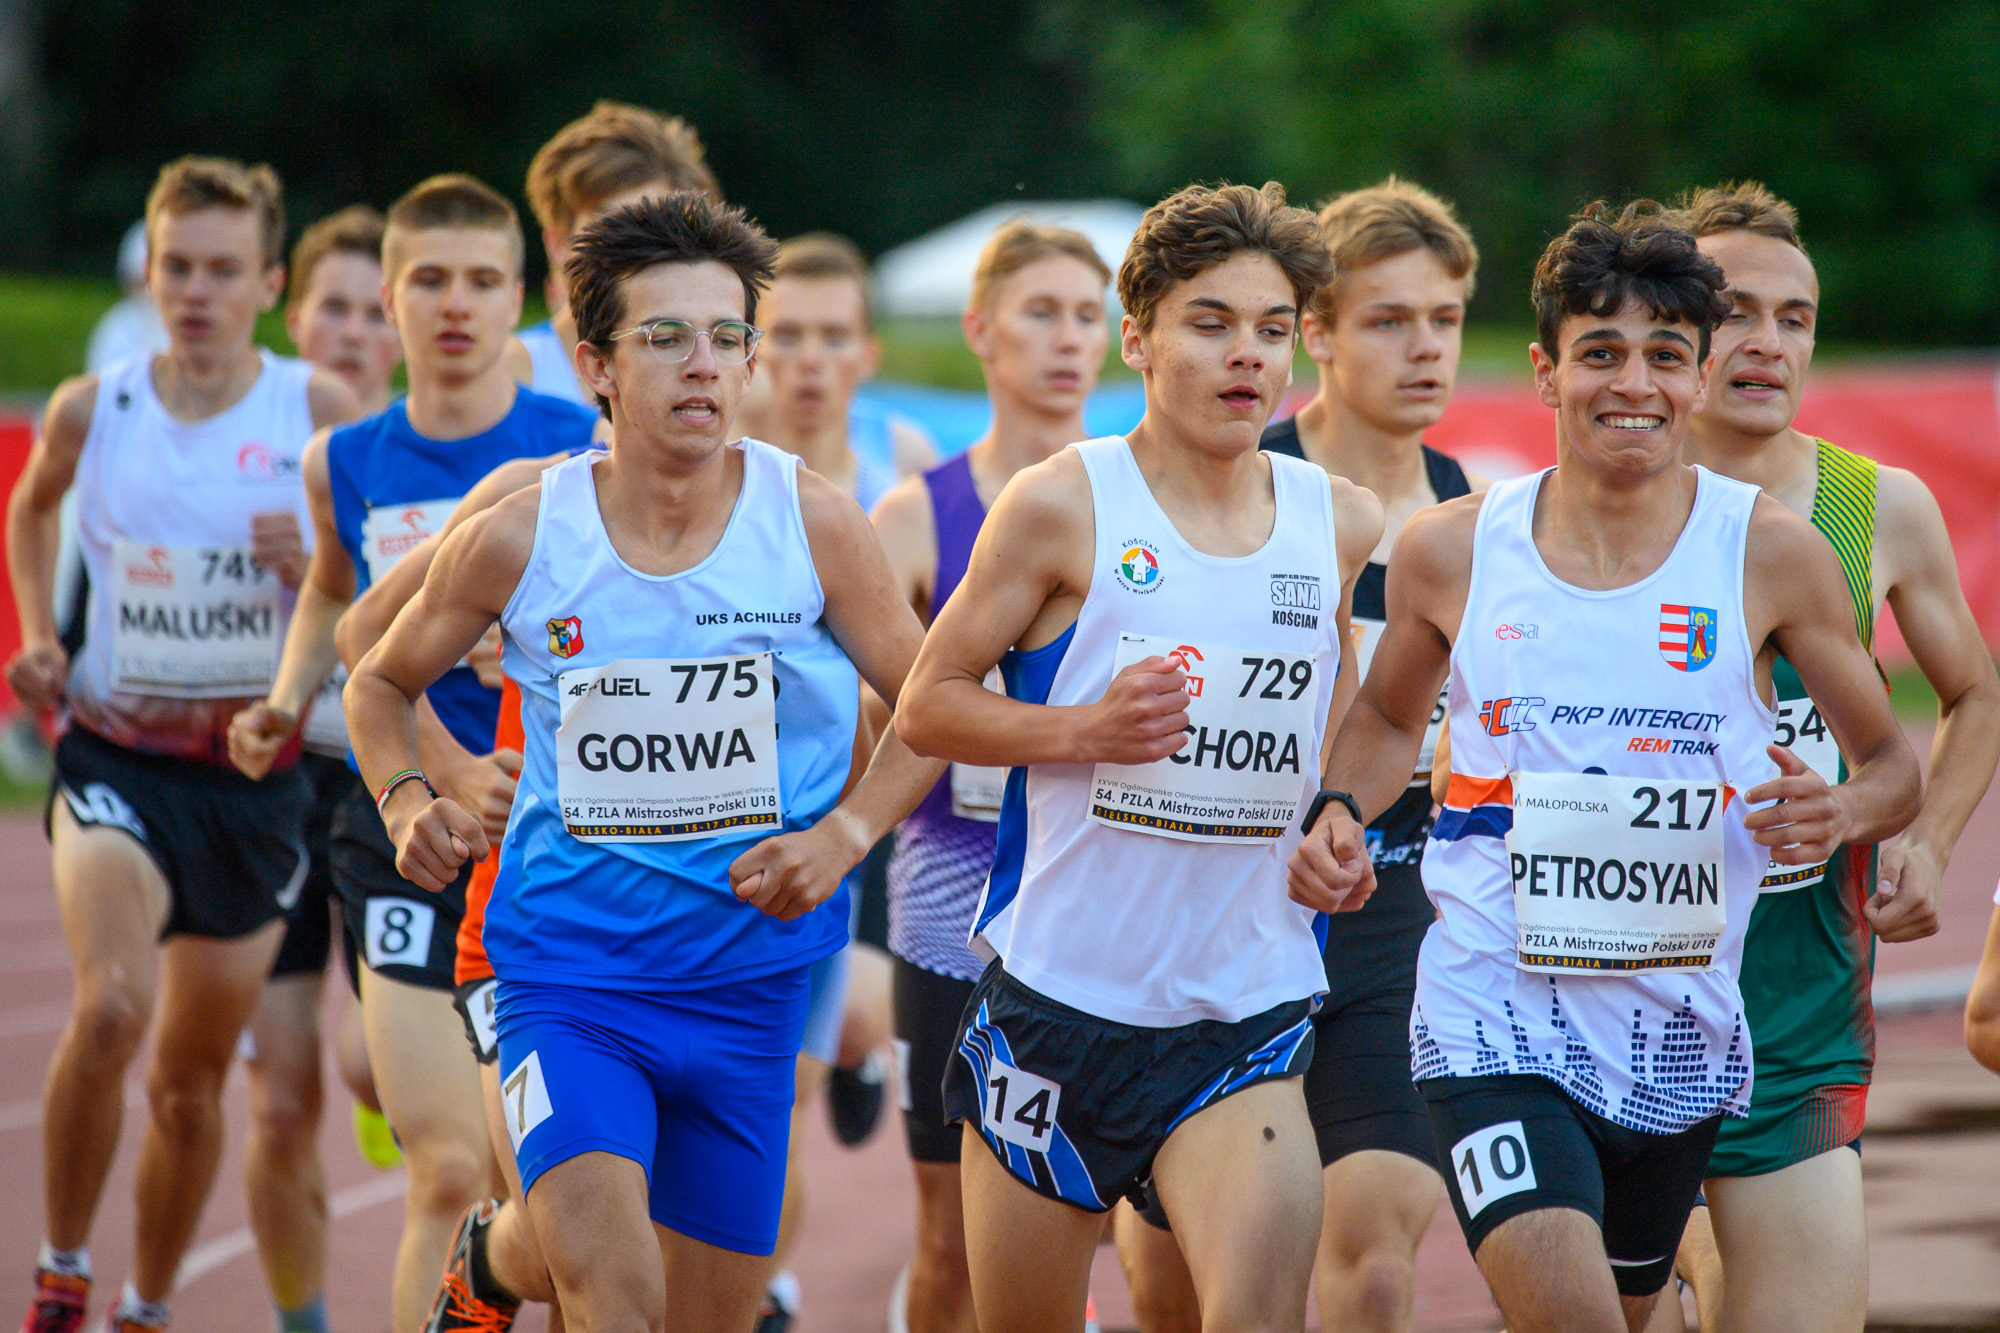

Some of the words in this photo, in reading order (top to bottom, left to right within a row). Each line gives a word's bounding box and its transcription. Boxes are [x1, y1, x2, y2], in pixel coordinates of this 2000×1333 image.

[1270, 580, 1321, 611] SANA
[119, 598, 273, 642] MALUŚKI
[695, 613, 729, 626] UKS
[733, 611, 802, 625] ACHILLES
[1272, 609, 1319, 631] KOŚCIAN
[670, 658, 759, 704] 775
[1238, 657, 1313, 701] 729
[1550, 705, 1605, 725] PKP
[1607, 707, 1727, 733] INTERCITY
[577, 727, 757, 773] GORWA
[1626, 737, 1720, 756] REMTRAK
[564, 806, 584, 819] 54.
[588, 807, 621, 819] PZLA
[624, 805, 704, 819] Mistrzostwa
[708, 797, 747, 814] Polski
[750, 795, 776, 808] U18
[1095, 788, 1115, 803] 54.
[1120, 792, 1154, 809] PZLA
[1158, 799, 1235, 819] Mistrzostwa
[1237, 807, 1271, 820] Polski
[1272, 808, 1294, 821] U18
[1120, 782, 1173, 798] Ogólnopolska
[1174, 791, 1213, 803] Olimpiada
[1214, 796, 1245, 804] Młodzieży
[1526, 798, 1609, 814] MAŁOPOLSKA
[1096, 807, 1193, 833] BIELSKO-BIAŁA
[1630, 786, 1717, 831] 217
[570, 826, 662, 835] BIELSKO-BIAŁA
[684, 815, 774, 832] 15-17.07.2022
[1510, 853, 1718, 906] PETROSYAN
[379, 906, 413, 954] 8
[1523, 923, 1576, 933] Ogólnopolska
[1577, 927, 1618, 936] Olimpiada
[1619, 931, 1658, 939] Młodzieży
[1525, 934, 1559, 948] PZLA
[1563, 936, 1648, 953] Mistrzostwa
[1651, 940, 1690, 952] Polski
[1691, 939, 1716, 950] U18
[1624, 956, 1708, 969] 15-17.07.2022
[504, 1064, 529, 1135] 7
[989, 1074, 1053, 1139] 14
[1458, 1134, 1527, 1198] 10
